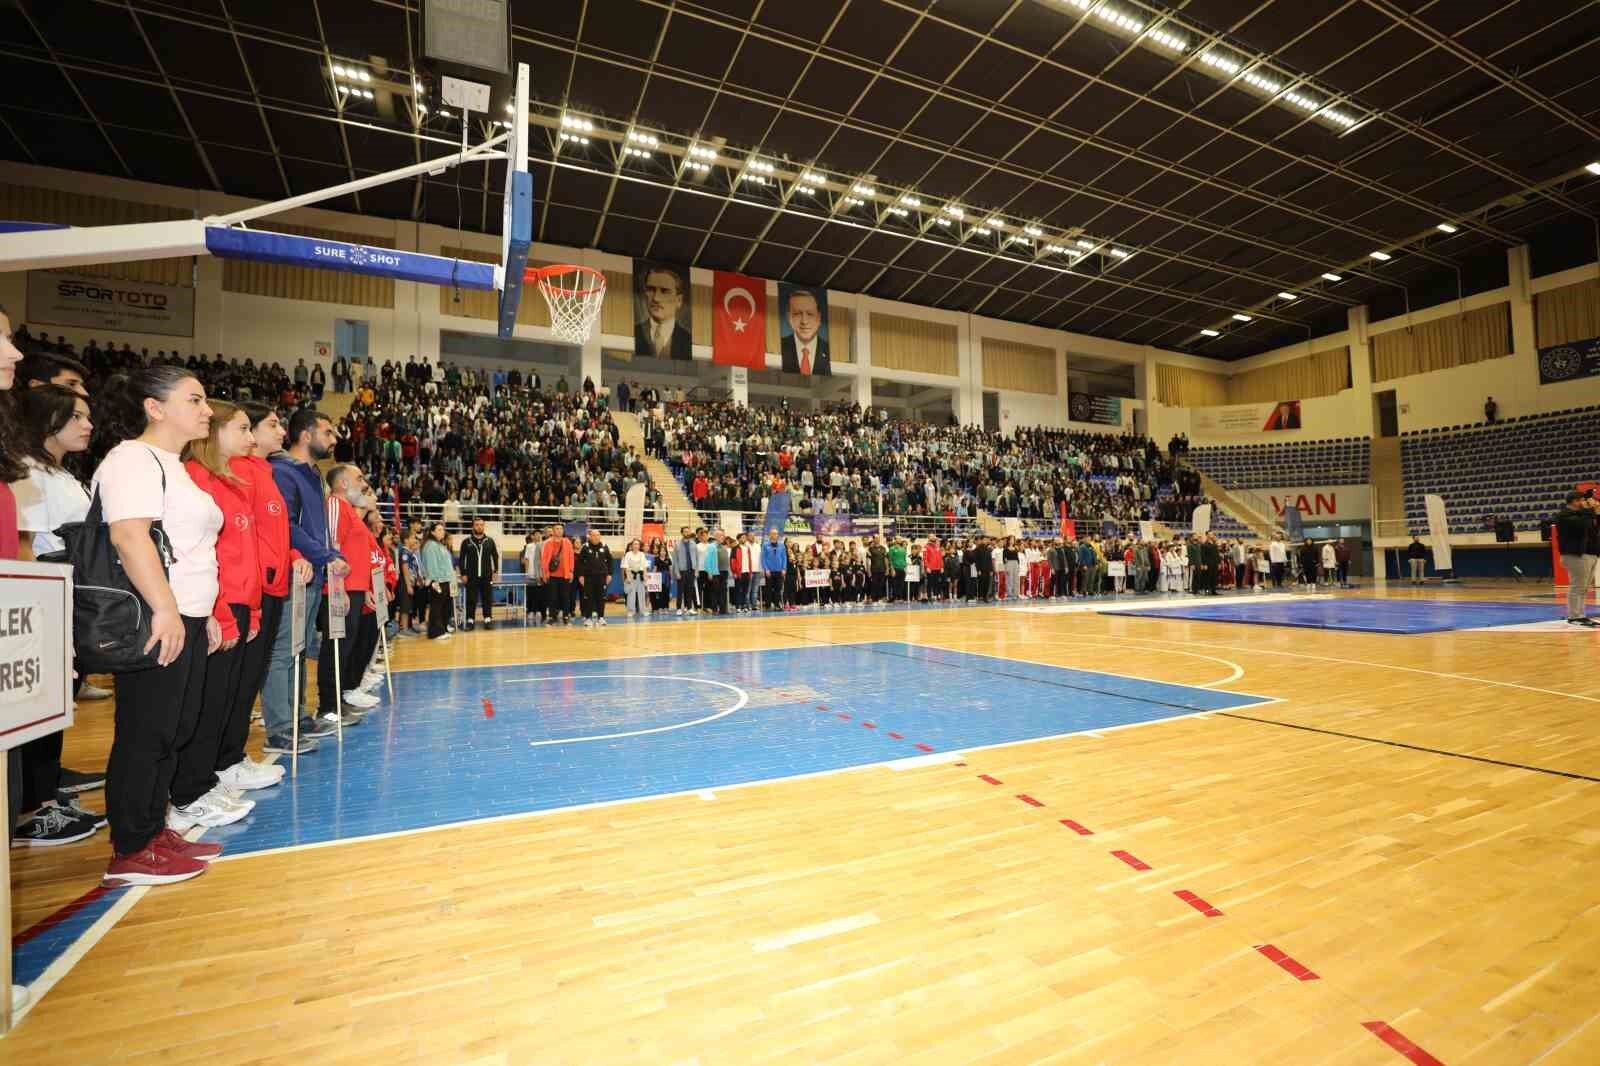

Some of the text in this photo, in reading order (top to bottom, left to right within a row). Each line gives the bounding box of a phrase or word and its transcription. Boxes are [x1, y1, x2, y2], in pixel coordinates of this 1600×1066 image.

[314, 246, 400, 266] SURE SHOT
[1270, 492, 1337, 517] VAN
